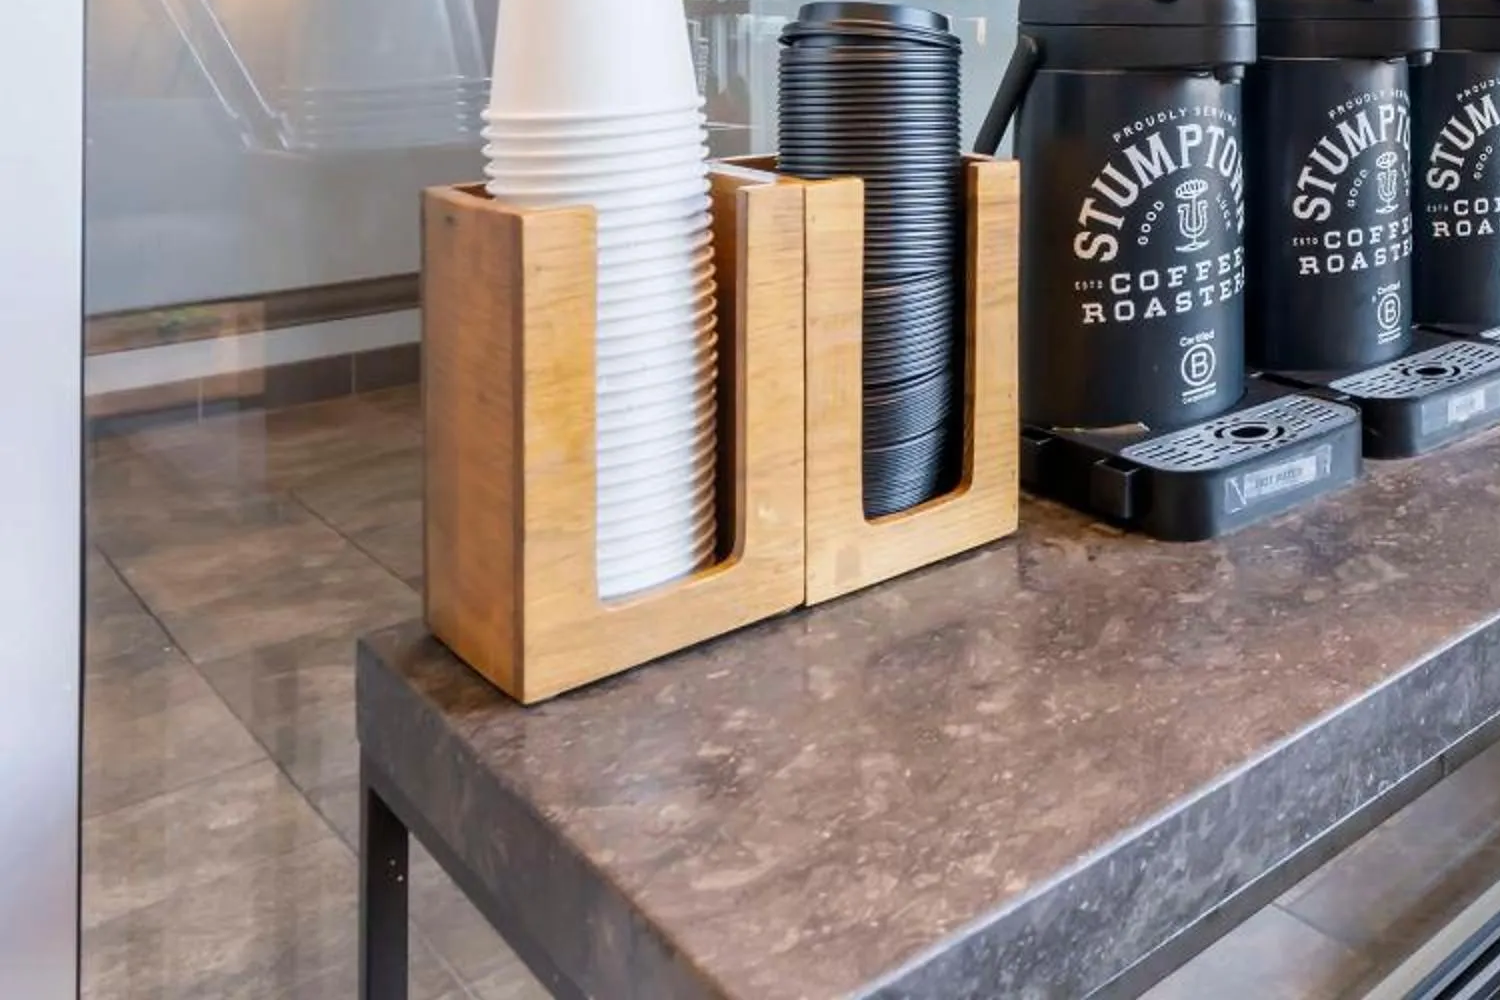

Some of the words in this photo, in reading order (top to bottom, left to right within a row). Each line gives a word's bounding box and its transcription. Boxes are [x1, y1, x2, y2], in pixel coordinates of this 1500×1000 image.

[1113, 107, 1186, 143] PROUDLY
[1292, 103, 1411, 222] STUMPTO
[1138, 199, 1165, 246] GOOD
[1323, 212, 1413, 249] COFFE
[1109, 246, 1245, 295] COFFEE
[1298, 234, 1413, 276] ROASTE
